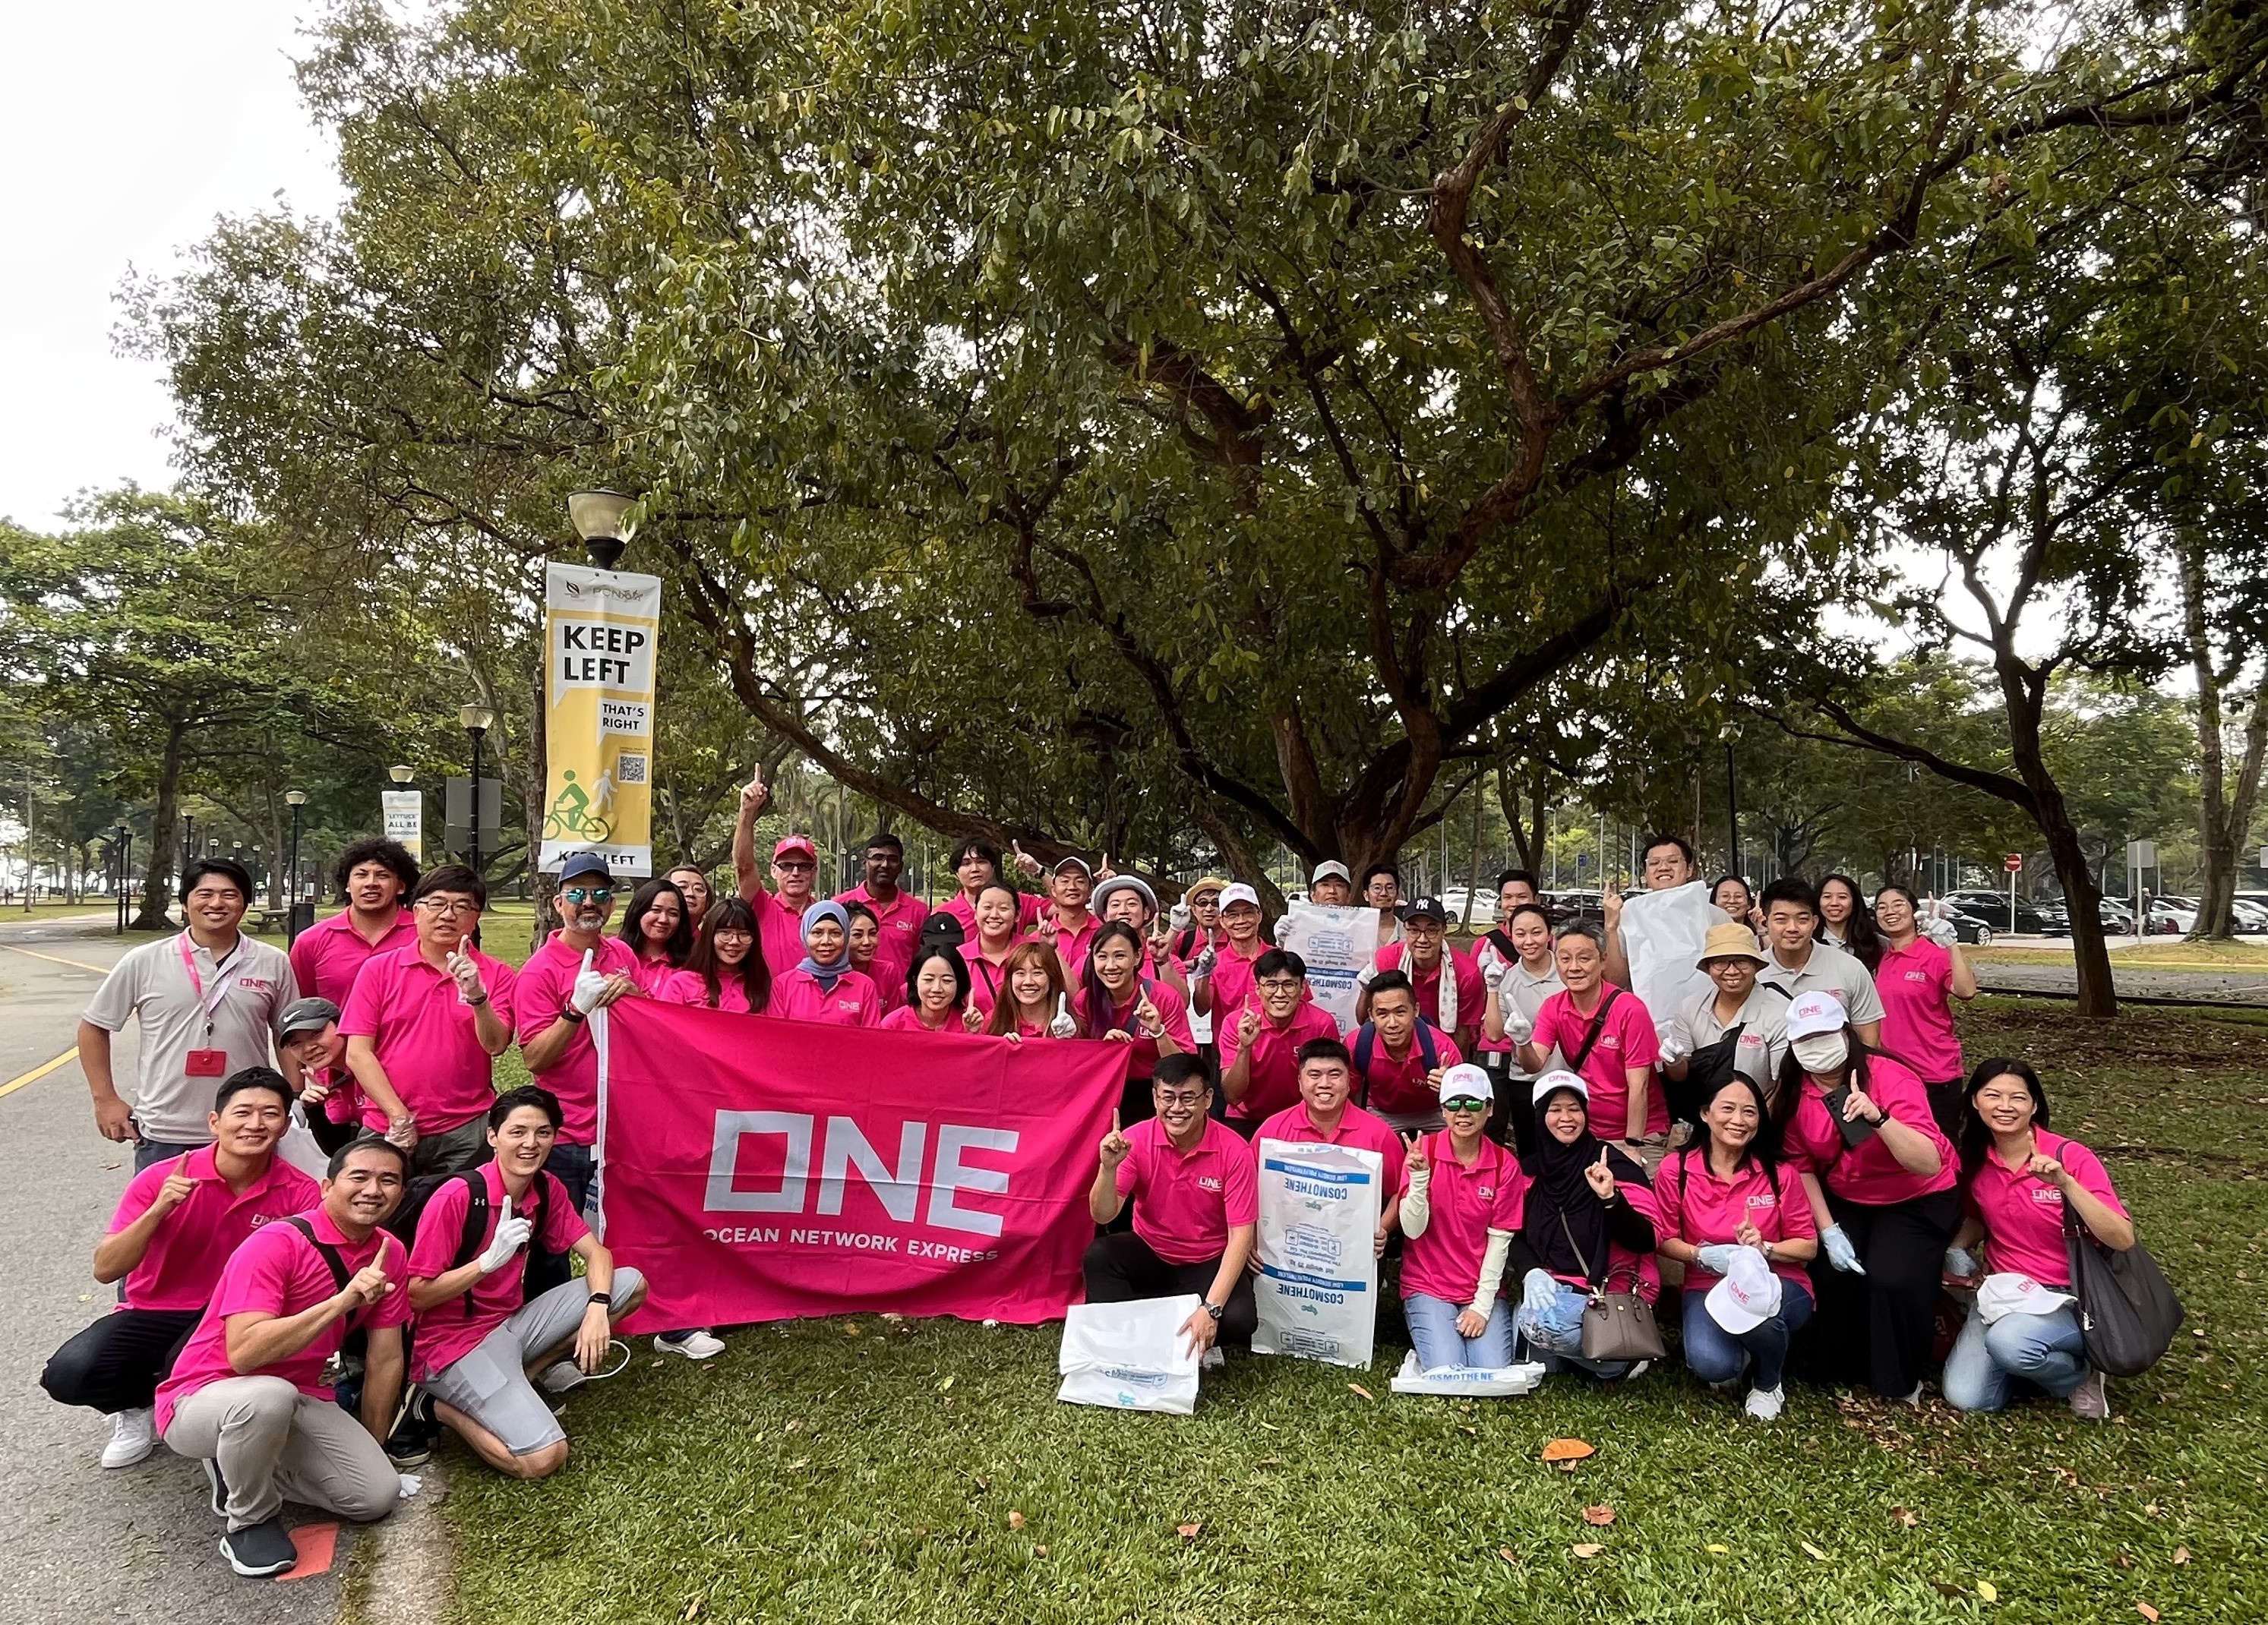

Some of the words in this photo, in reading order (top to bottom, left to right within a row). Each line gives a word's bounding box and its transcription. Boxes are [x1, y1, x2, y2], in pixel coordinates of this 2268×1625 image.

[564, 625, 645, 655] KEEP
[564, 657, 630, 684] LEFT
[602, 703, 644, 717] THAT'S
[602, 718, 640, 730] RIGHT
[603, 854, 635, 865] LEFT
[1799, 1005, 1821, 1017] ONE
[1740, 1036, 1761, 1045] ONE
[703, 1109, 1020, 1238] ONE
[1747, 1194, 1774, 1206] ONE
[2033, 1189, 2061, 1200] ONE
[703, 1227, 780, 1245] OCEAN
[790, 1229, 898, 1253] NETWORK
[907, 1239, 999, 1264] EXPRESS
[1278, 1283, 1344, 1305] COSMOTHENE
[1731, 1281, 1750, 1303] ONE
